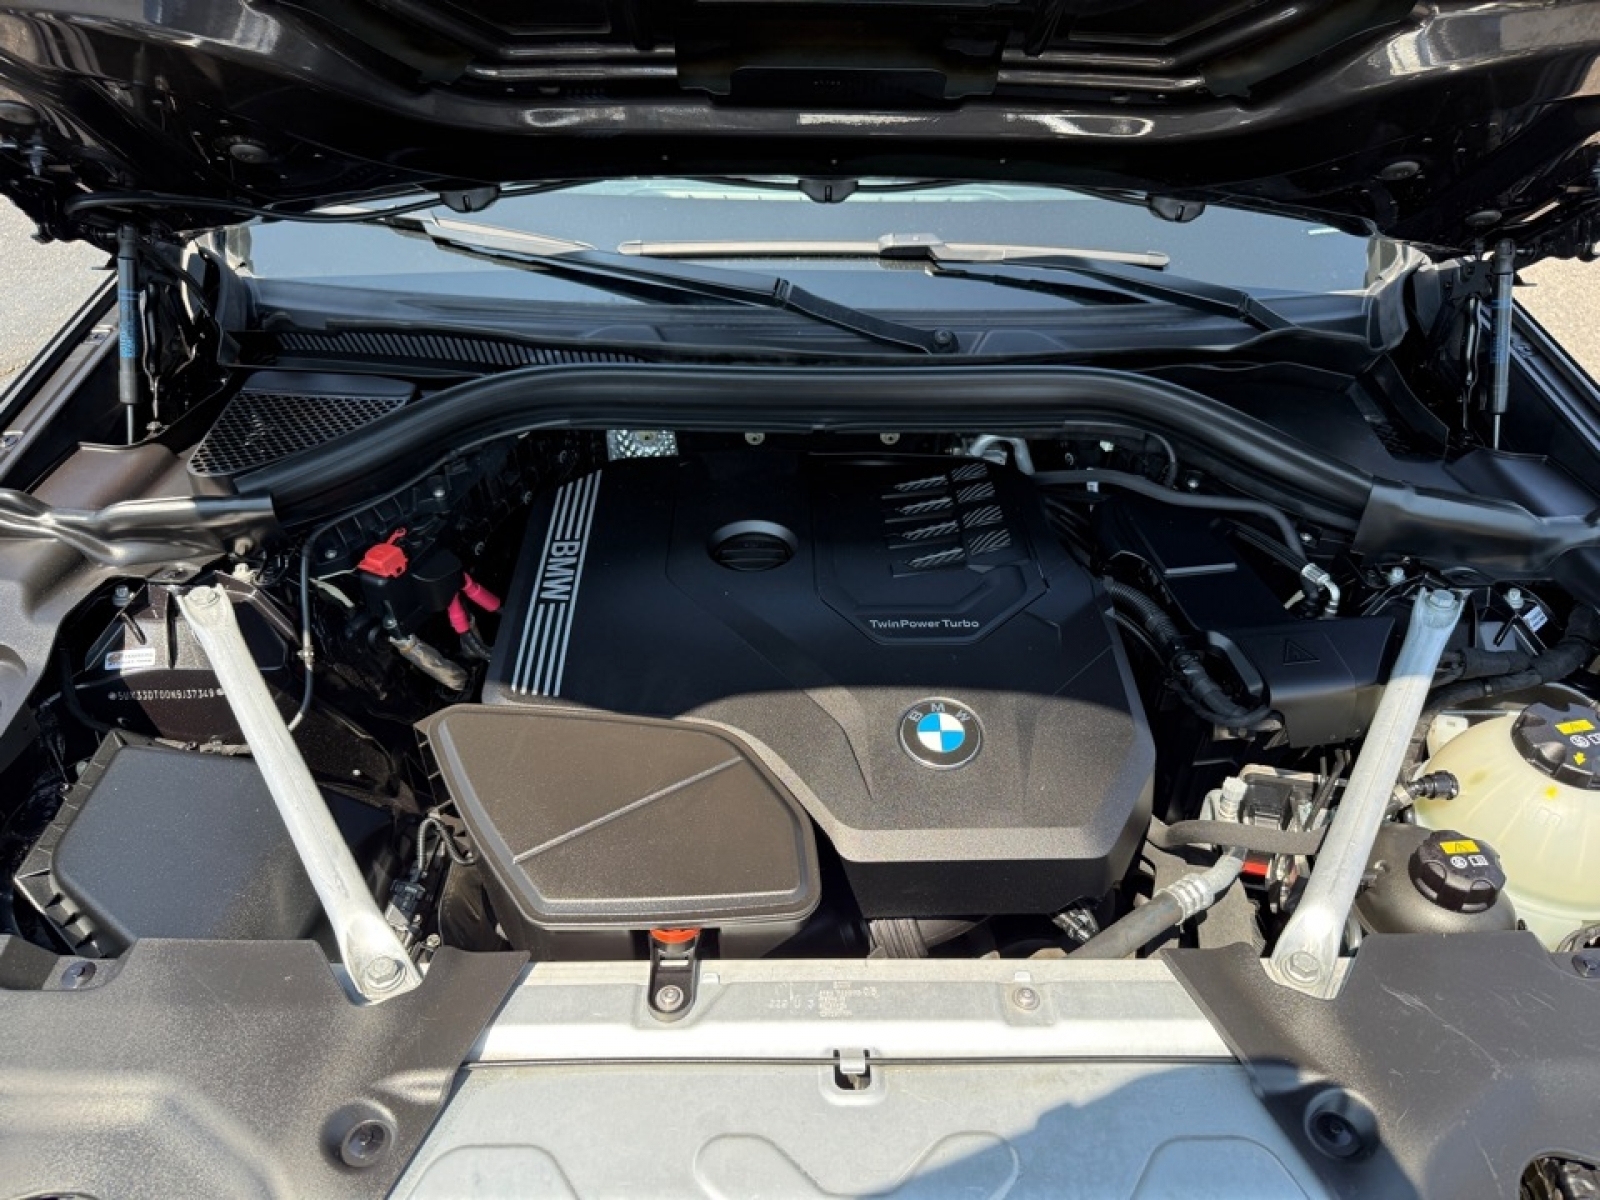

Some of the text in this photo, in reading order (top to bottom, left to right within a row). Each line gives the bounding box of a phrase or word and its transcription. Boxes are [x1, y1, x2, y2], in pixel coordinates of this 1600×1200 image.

[540, 541, 580, 601] BMW
[941, 619, 980, 628] Turbo
[908, 703, 971, 722] BMW
